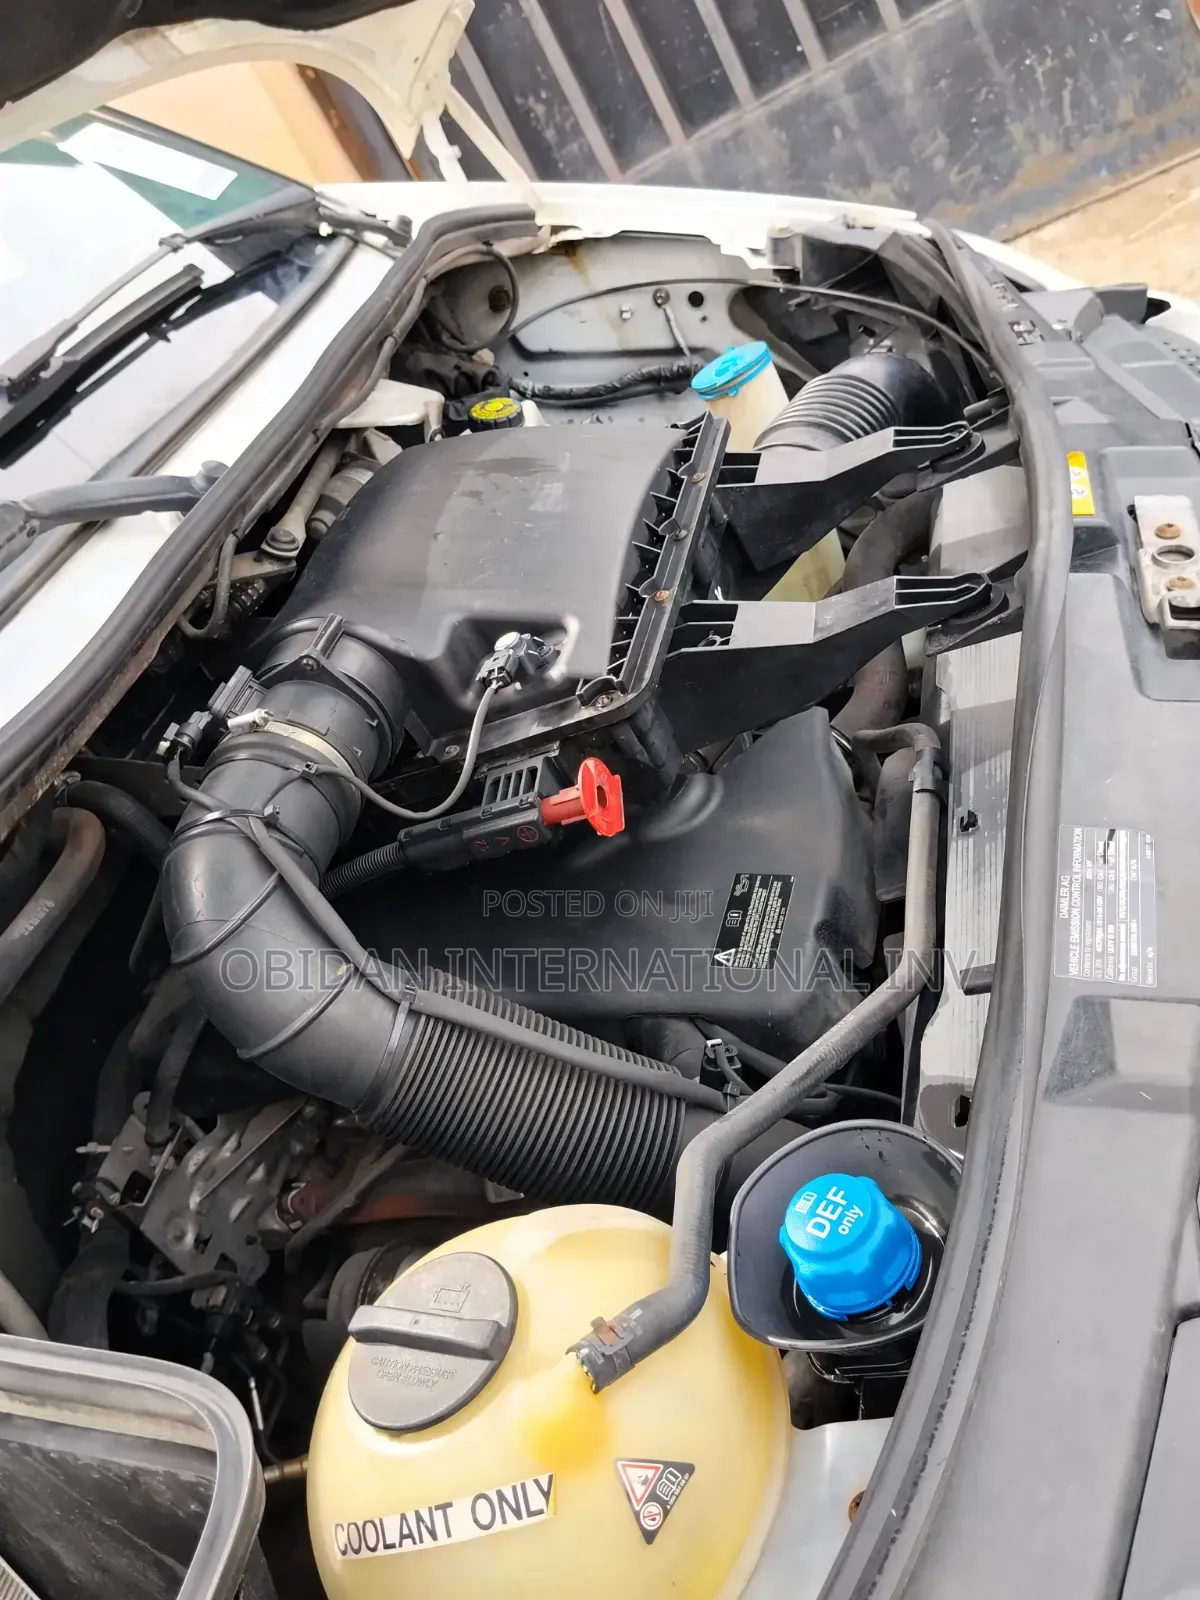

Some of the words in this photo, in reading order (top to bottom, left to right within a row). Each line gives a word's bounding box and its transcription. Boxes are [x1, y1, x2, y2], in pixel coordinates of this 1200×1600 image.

[1073, 828, 1083, 872] INFORMATION
[1061, 876, 1069, 886] AG
[1071, 873, 1081, 906] CONTROL
[1060, 887, 1069, 918] DAIMLER
[1070, 908, 1080, 942] EMISSION
[1070, 944, 1079, 975] VEHICLE
[805, 1185, 848, 1239] DEF
[838, 1204, 864, 1235] only
[371, 1356, 410, 1372] CAUTION
[408, 1363, 458, 1380] PRESSURE
[376, 1369, 401, 1381] OPEN
[401, 1374, 438, 1389] SLOWLY
[334, 1502, 454, 1556] COOLANT
[471, 1474, 554, 1531] ONLY
